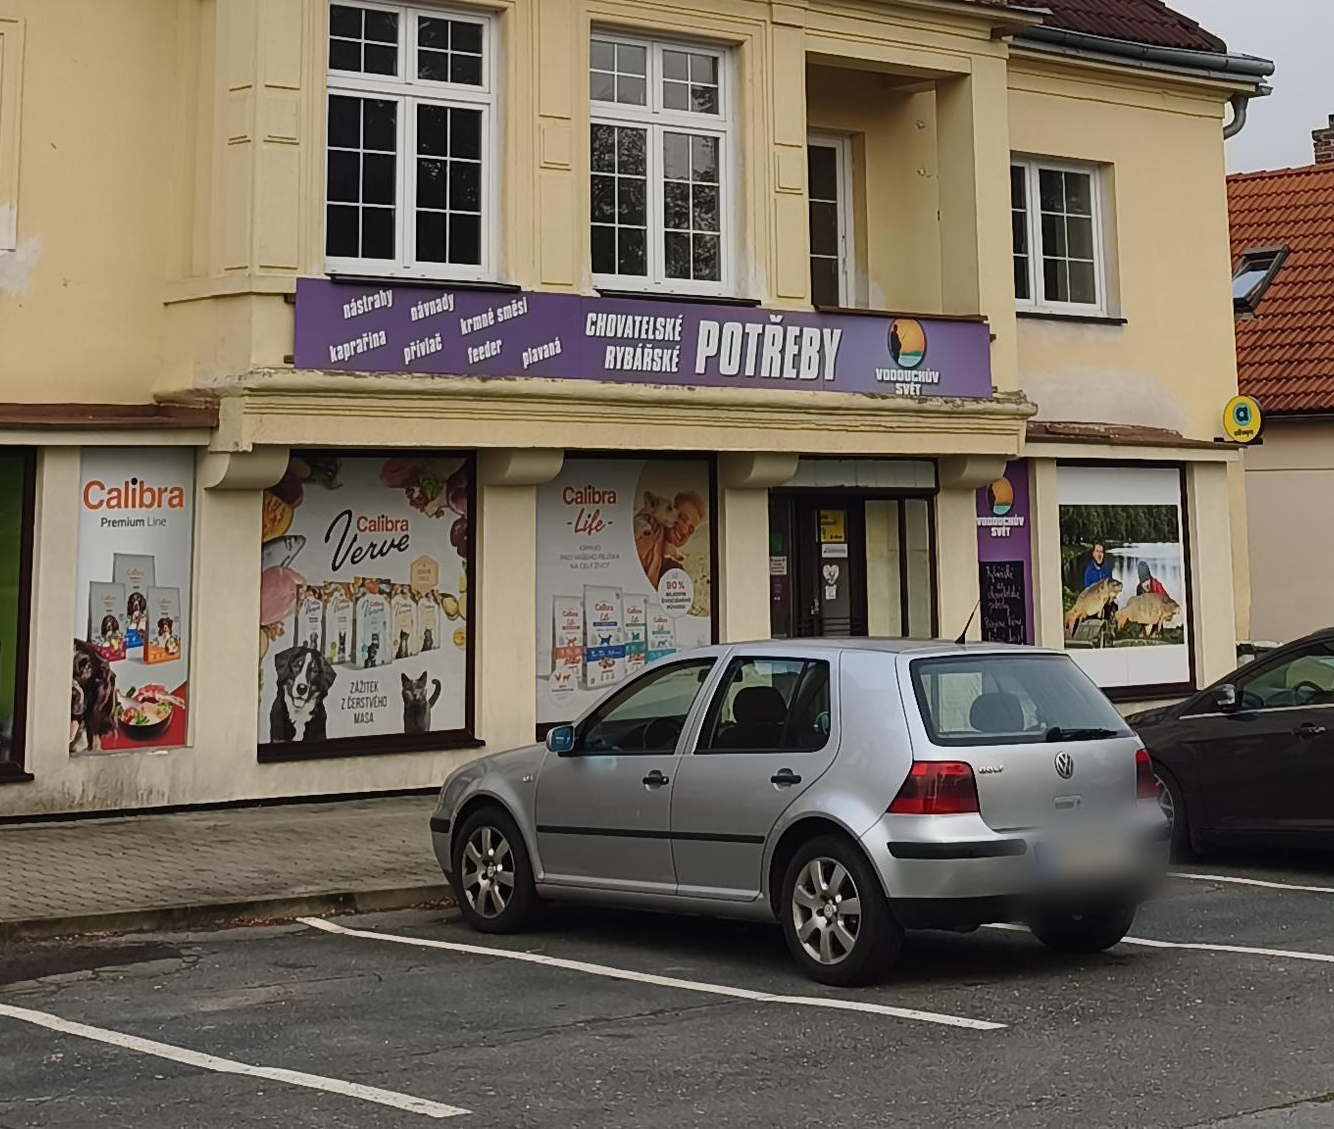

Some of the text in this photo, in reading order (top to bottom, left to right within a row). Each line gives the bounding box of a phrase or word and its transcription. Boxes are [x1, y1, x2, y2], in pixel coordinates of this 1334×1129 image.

[342, 288, 394, 320] nástrahy
[410, 292, 455, 322] návnady
[460, 296, 529, 336] krmné směsi
[585, 312, 684, 341] CHOVATELSKÉ
[329, 329, 387, 363] kaprařina
[403, 332, 443, 365] přívlač
[467, 338, 503, 364] feeder
[522, 336, 562, 369] plavaná
[604, 342, 680, 372] RYBÁŘSKÉ
[694, 314, 843, 381] POTŘEBY
[83, 477, 184, 510] Calibra
[563, 485, 617, 505] Calibra
[100, 516, 167, 527] Premium Line
[357, 514, 409, 533] Calibra
[574, 508, 607, 535] Life
[324, 509, 410, 572] Verve
[353, 711, 374, 724] MASA
